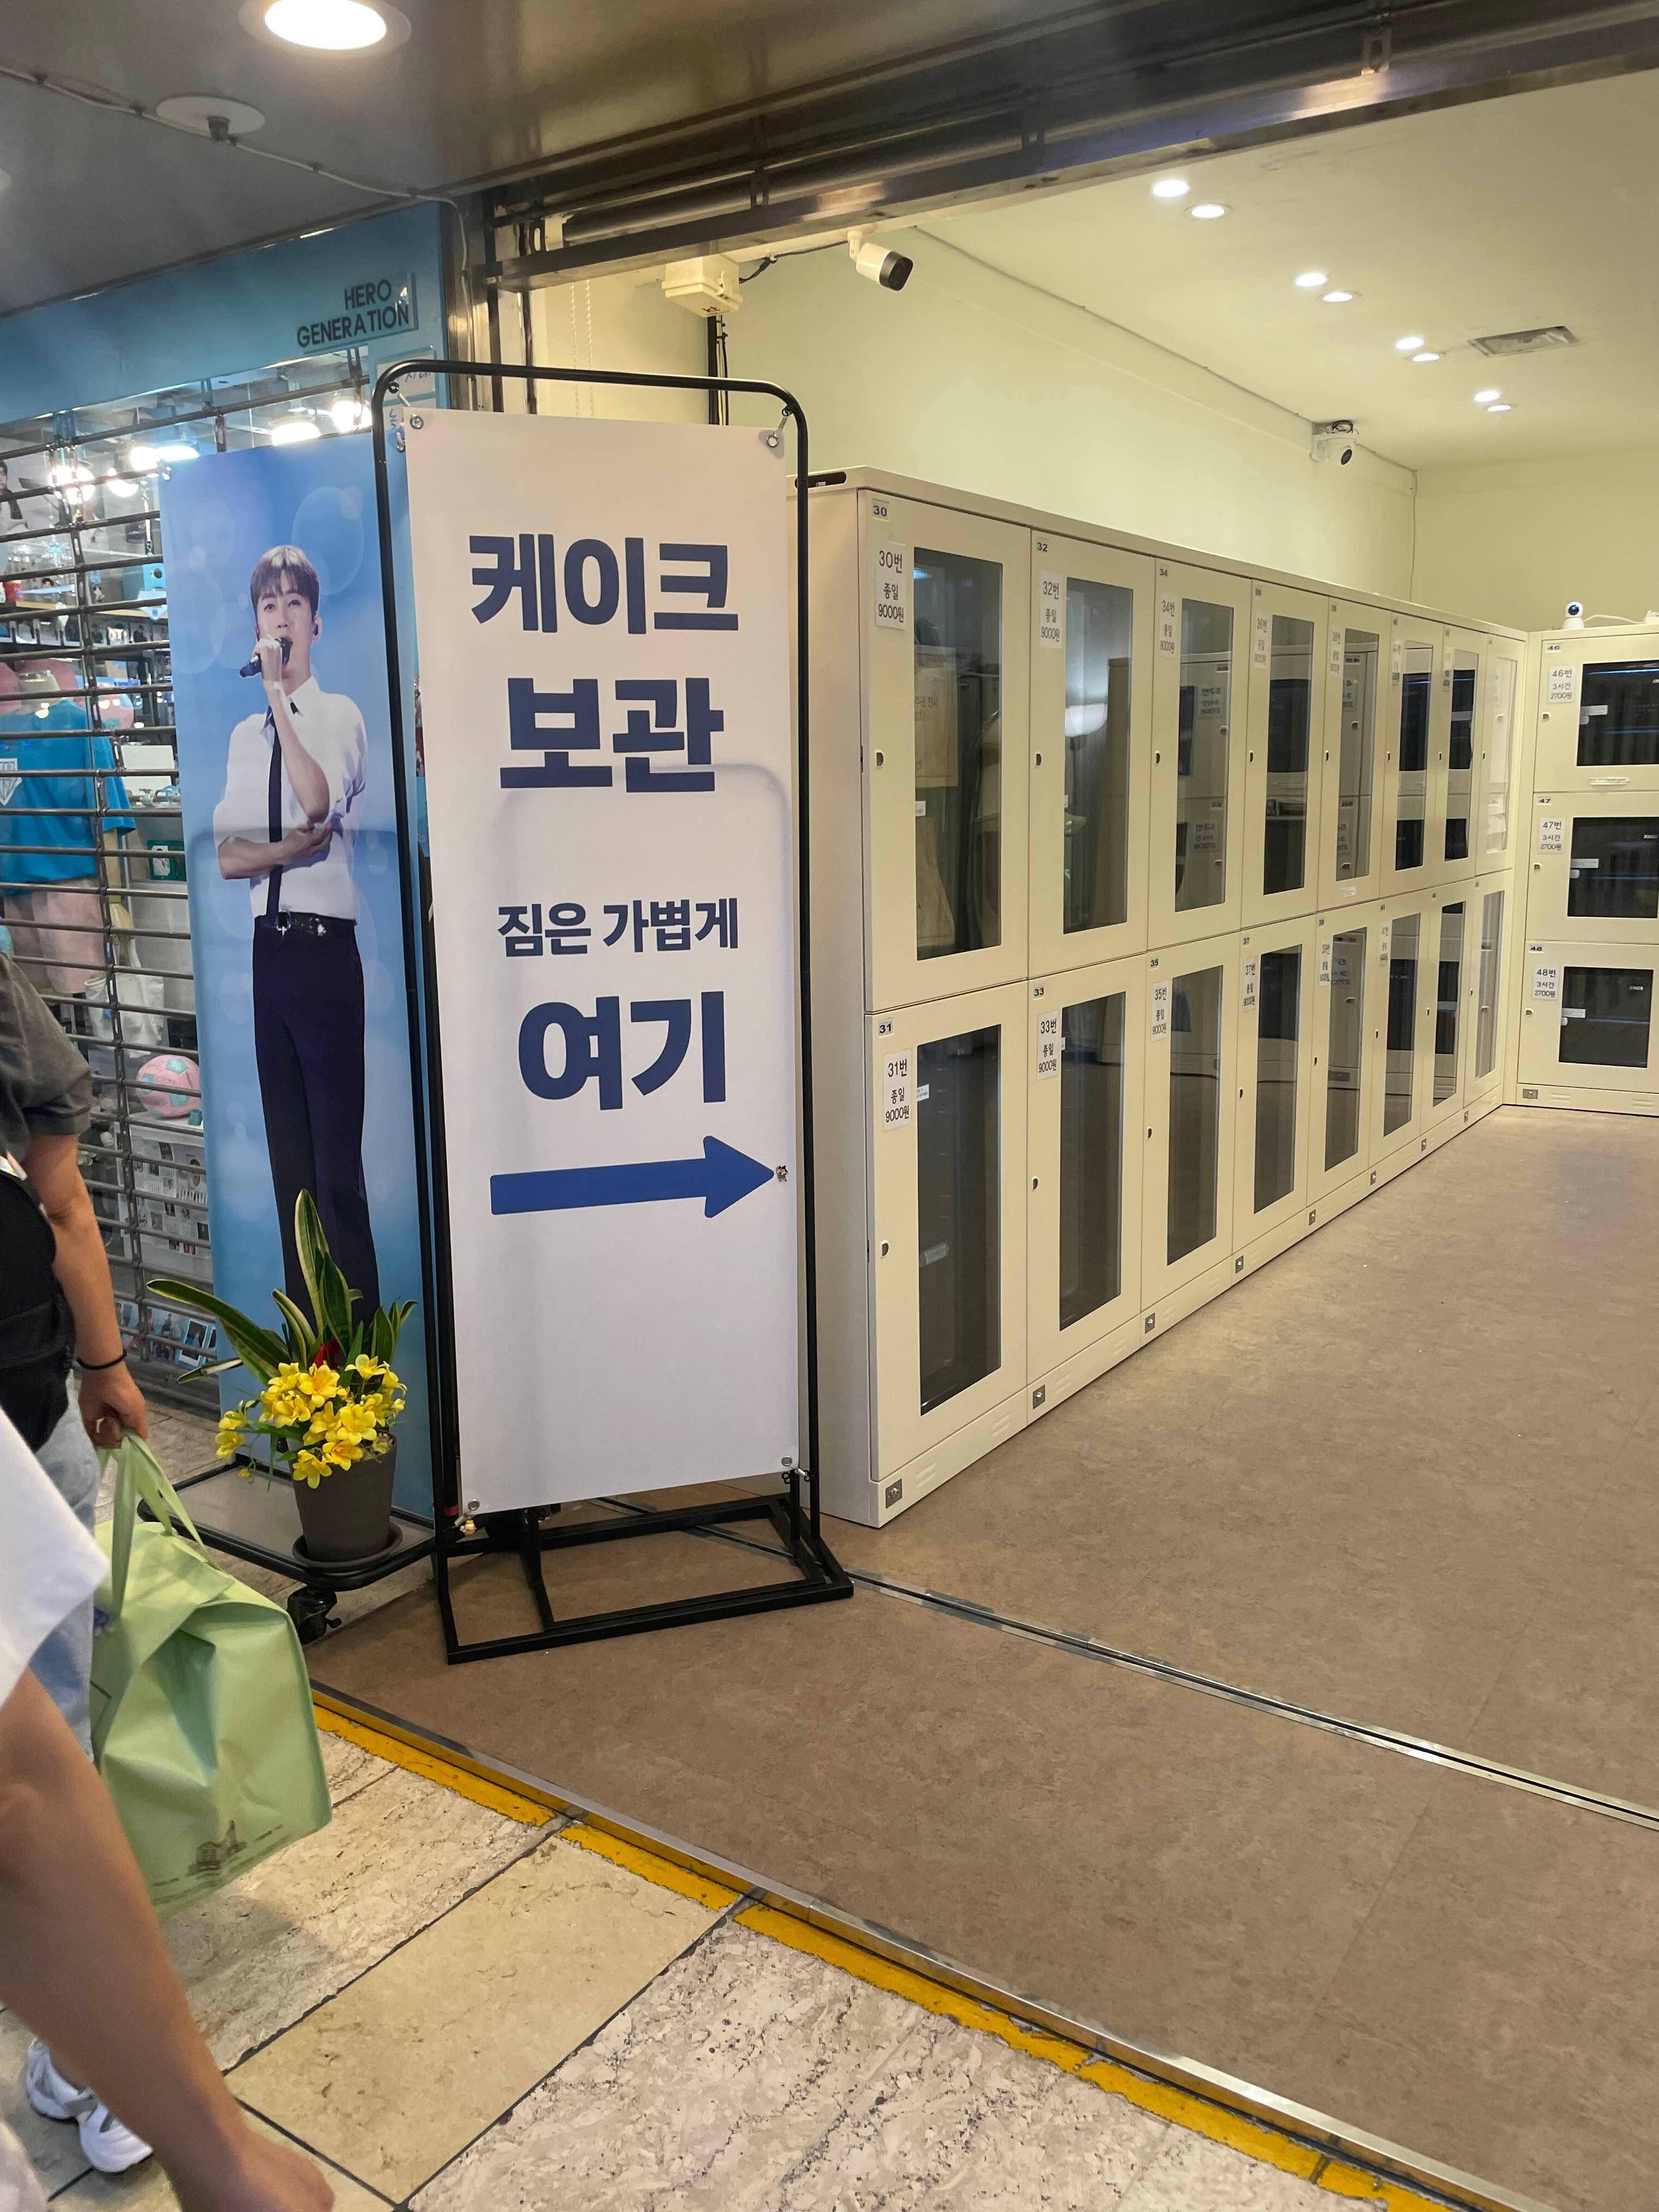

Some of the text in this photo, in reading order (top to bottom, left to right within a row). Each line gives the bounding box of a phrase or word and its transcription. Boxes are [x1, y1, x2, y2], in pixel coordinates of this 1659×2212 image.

[344, 279, 392, 310] HERO
[297, 303, 409, 348] GENERATION
[873, 505, 887, 517] 30
[1036, 542, 1048, 552] 32
[879, 550, 902, 573] 30번
[469, 534, 738, 634] 케이크
[883, 583, 899, 600] 종일
[1043, 581, 1059, 600] 32번
[878, 604, 904, 623] 9000원
[1045, 608, 1057, 623] 종일
[1162, 600, 1175, 617] 34번
[1041, 627, 1060, 642] 9000원
[1552, 669, 1572, 678] 46번
[500, 678, 724, 792] 보관
[1543, 821, 1562, 830] 47번
[498, 898, 738, 957] 짐은 가볍게
[1150, 959, 1159, 967] 35
[1536, 969, 1556, 978] 48번
[1034, 988, 1044, 996] 33
[1154, 987, 1167, 1001] 35번
[879, 1023, 892, 1034] 31
[1040, 1018, 1057, 1034] 33번
[1152, 1023, 1166, 1035] 9000원
[518, 991, 726, 1110] 여기
[1043, 1043, 1054, 1057] 종일
[888, 1059, 907, 1077] 31번
[1039, 1058, 1057, 1073] 9000원
[891, 1087, 905, 1104] 종일
[885, 1105, 910, 1122] 9000원
